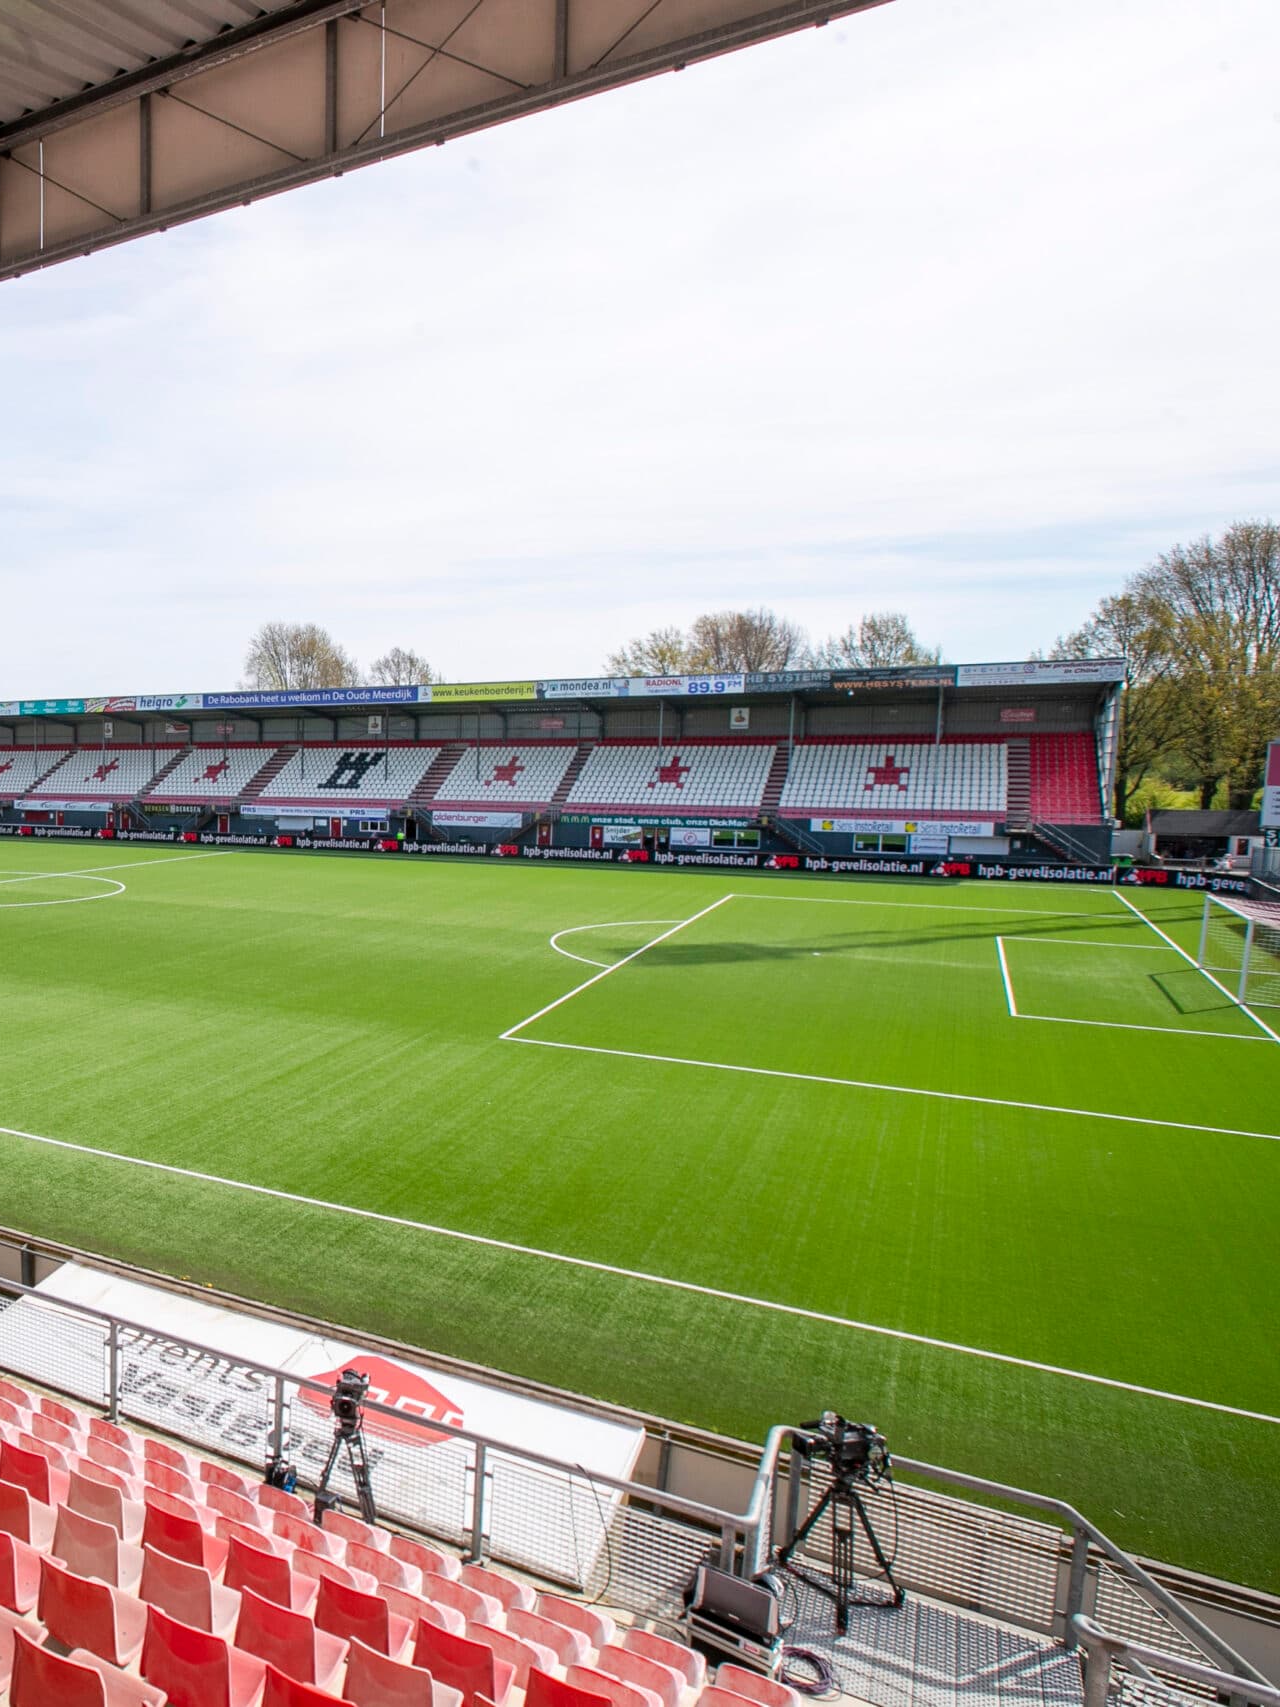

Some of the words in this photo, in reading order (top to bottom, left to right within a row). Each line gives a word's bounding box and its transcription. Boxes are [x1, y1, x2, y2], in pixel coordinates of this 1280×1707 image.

[645, 679, 682, 687] RADIONL
[769, 671, 831, 683] SYSTEMS
[432, 685, 535, 698] www.keukenboerderij.nl
[687, 681, 725, 694] 89.9
[727, 679, 742, 688] FM
[208, 696, 219, 704] De
[220, 695, 259, 704] Rabobank
[261, 694, 279, 703] heet
[288, 692, 320, 702] welkom
[322, 691, 331, 701] in
[332, 691, 345, 701] De
[346, 690, 371, 700] Oude
[372, 688, 413, 701] Meerdijk
[433, 813, 488, 823] oldenburger
[116, 828, 174, 841] hpb-gevelisolatie.nl
[200, 833, 267, 845] hpb-gevelisolatie.nl
[296, 836, 370, 850] hpb-gevelisolatie.nl
[403, 840, 487, 855] hpb-gevelisolatie.nl
[523, 845, 613, 860] hpb-gevelisolatie.nl
[654, 851, 758, 866] hpb-gevelisolatie.nl
[805, 856, 923, 873] hpb-gevelisolatie.nl
[978, 863, 1113, 880] hpb-gevelisolatie.nl
